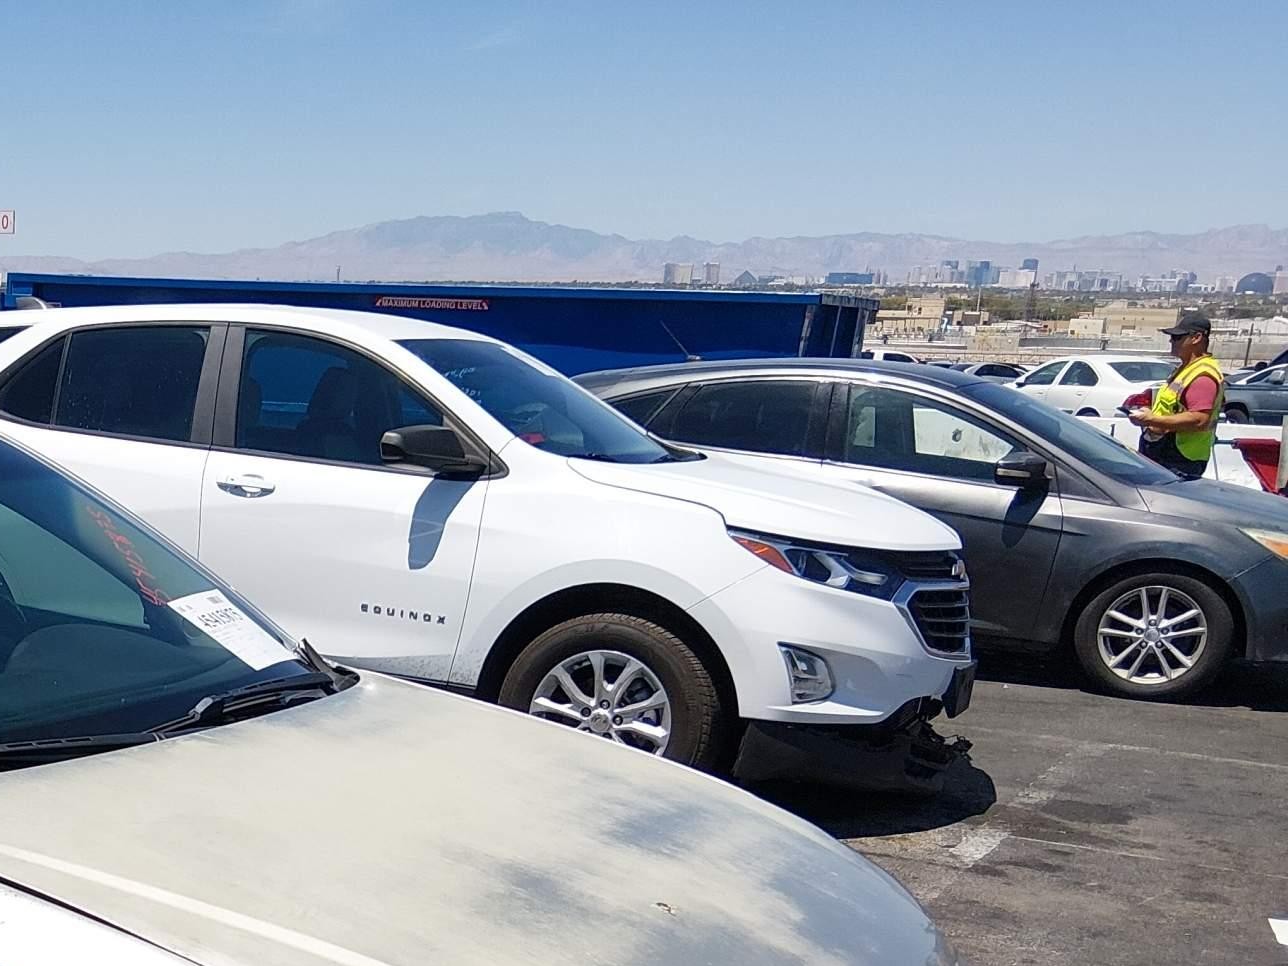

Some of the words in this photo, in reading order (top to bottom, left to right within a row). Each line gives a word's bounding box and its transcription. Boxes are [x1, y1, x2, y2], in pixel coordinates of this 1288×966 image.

[381, 298, 419, 308] MAXIMUM
[420, 300, 456, 310] LOADING
[457, 301, 482, 310] LEVEL
[360, 603, 446, 625] EQUINOX
